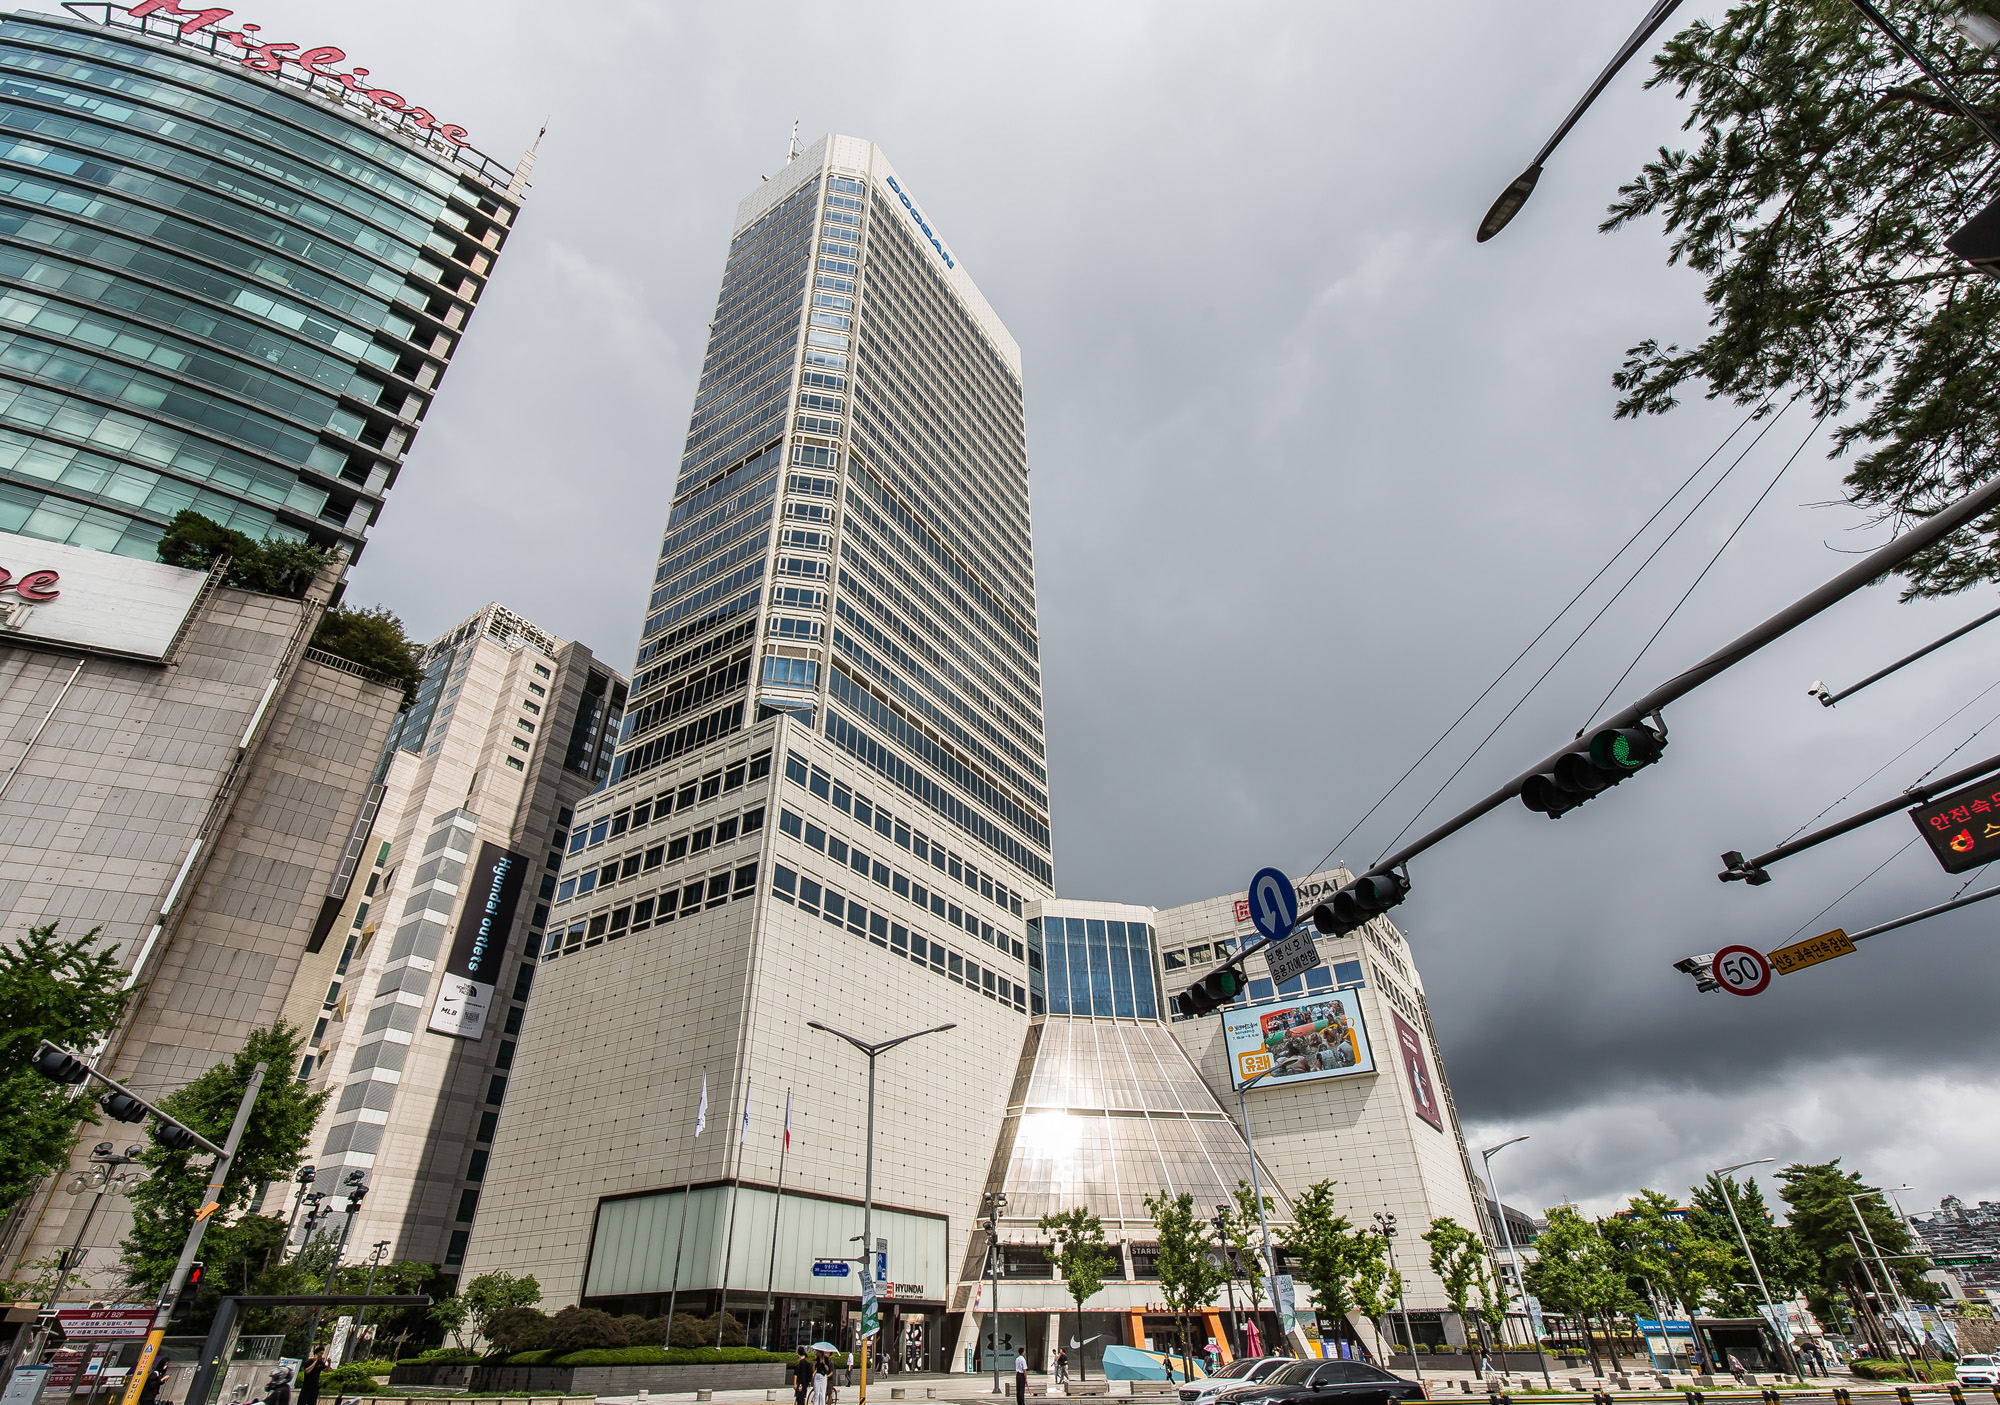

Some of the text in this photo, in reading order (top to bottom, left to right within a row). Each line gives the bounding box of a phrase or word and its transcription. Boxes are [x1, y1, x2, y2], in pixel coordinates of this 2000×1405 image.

[886, 175, 954, 270] DOOSAN
[1297, 879, 1340, 900] NDAI
[468, 856, 513, 972] Hyundai outlets
[1723, 956, 1759, 985] 50
[440, 1007, 458, 1016] MLB
[1245, 1054, 1271, 1072] 유쾌
[1131, 1247, 1161, 1255] STARBU
[895, 1283, 924, 1294] HYUNDAI
